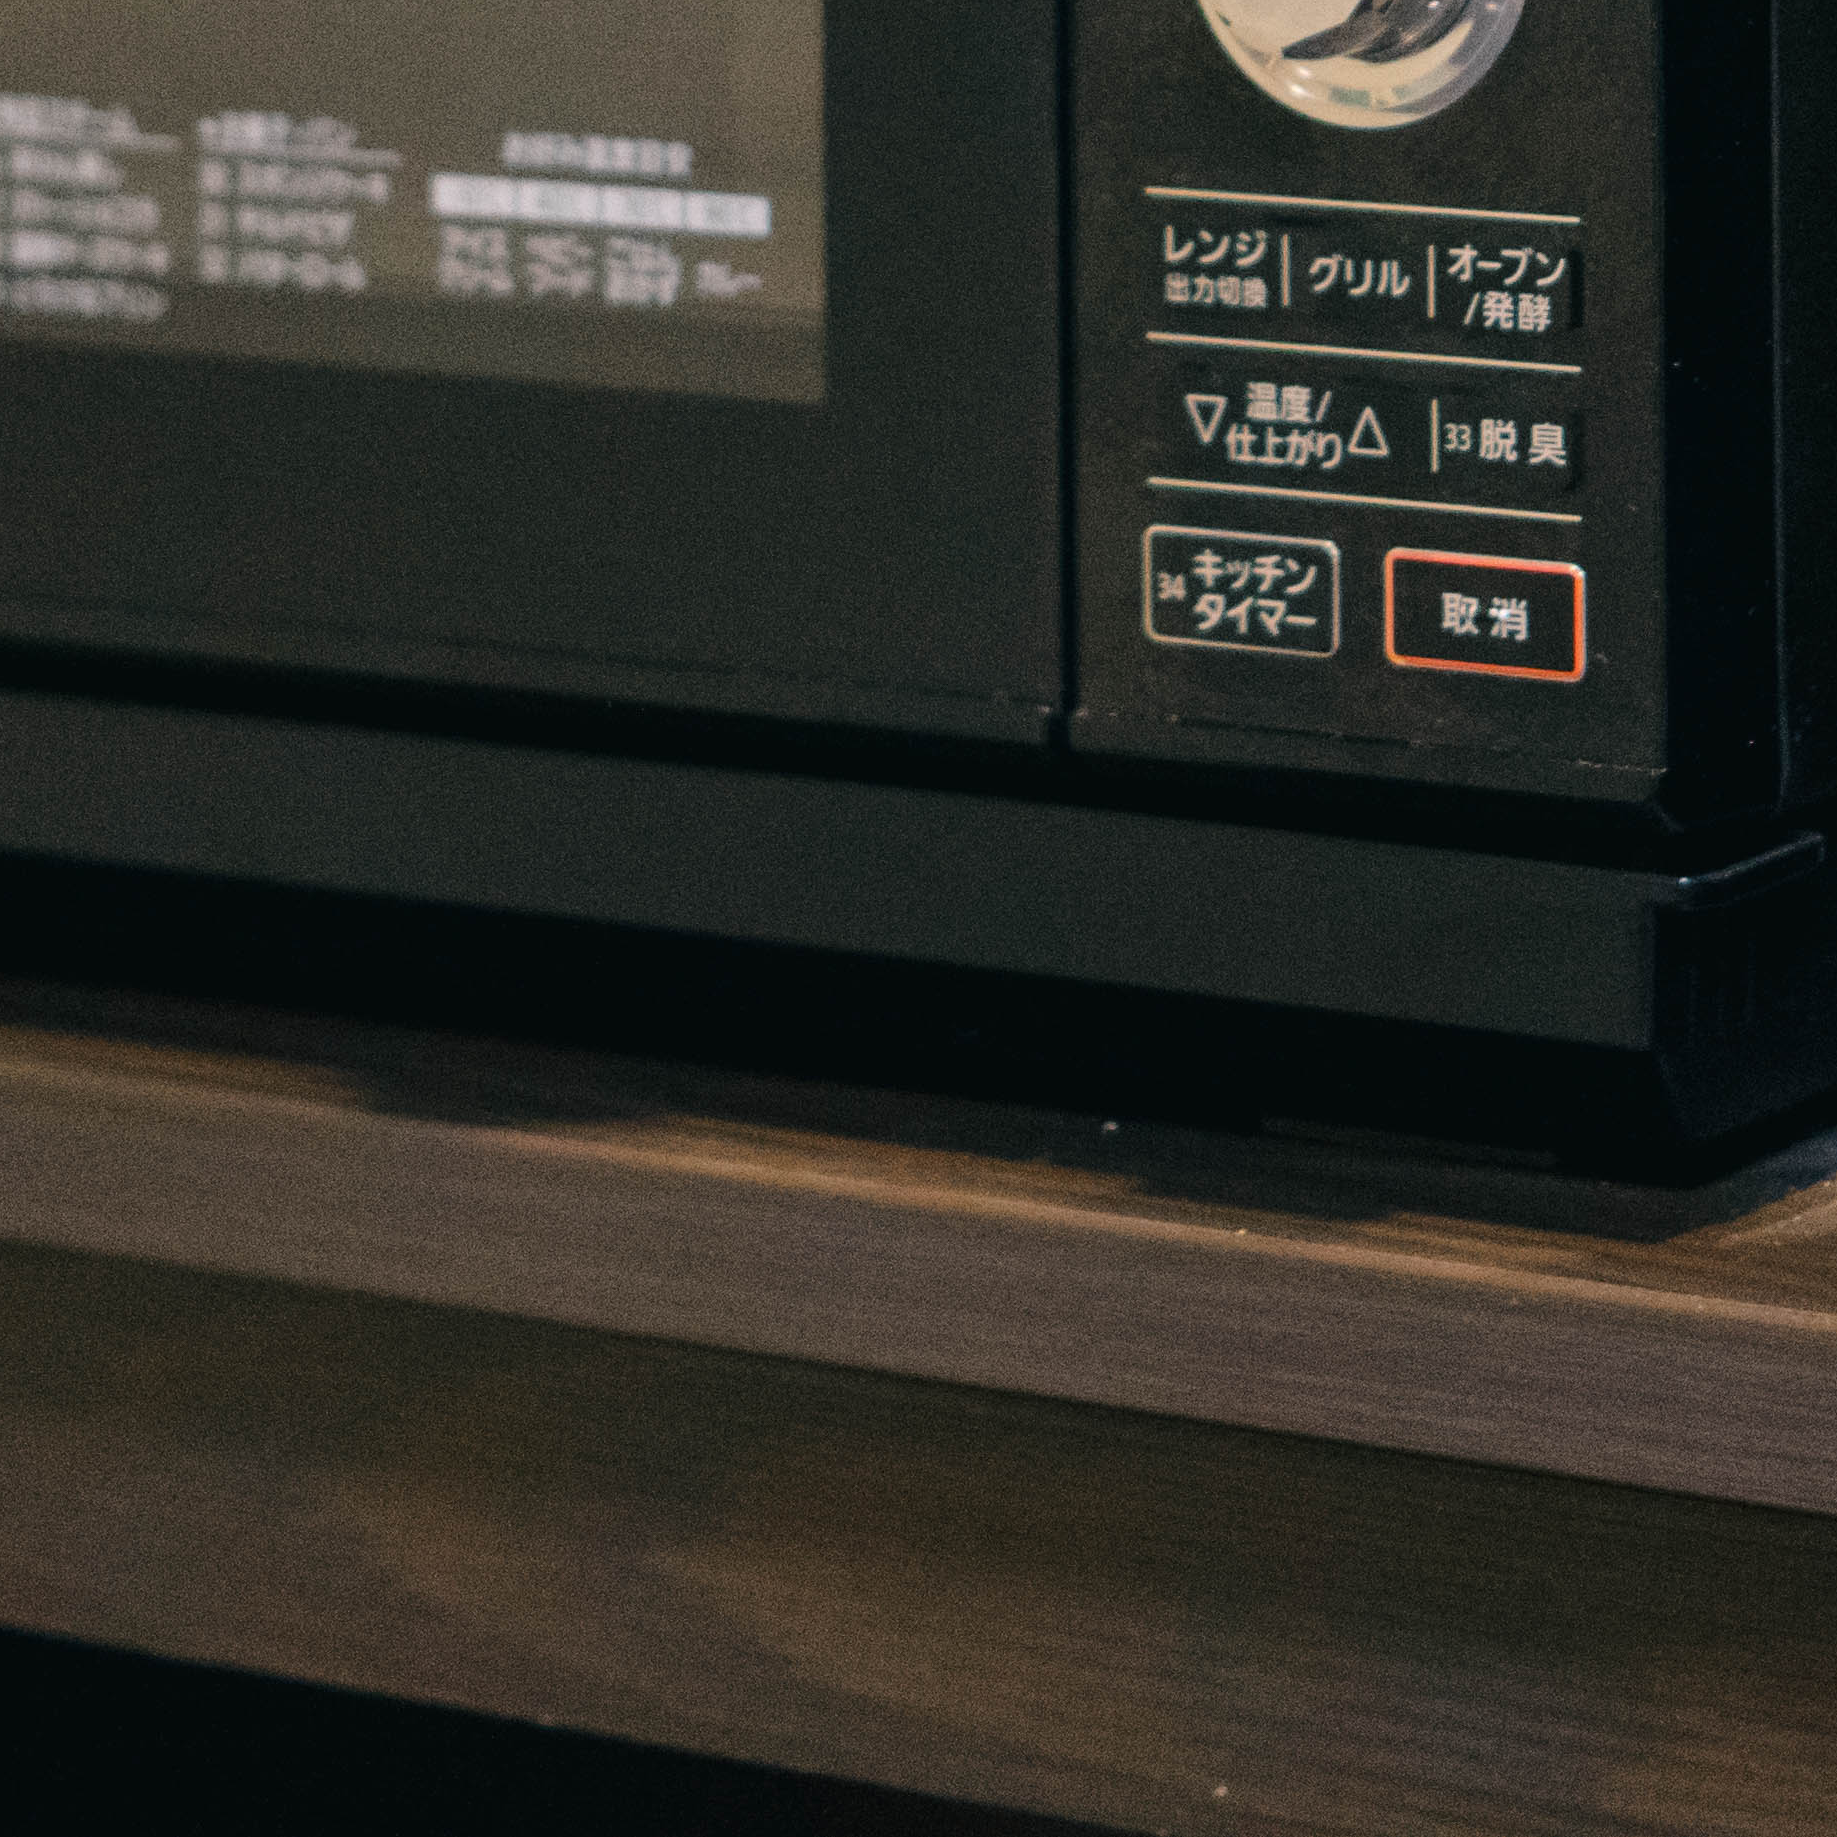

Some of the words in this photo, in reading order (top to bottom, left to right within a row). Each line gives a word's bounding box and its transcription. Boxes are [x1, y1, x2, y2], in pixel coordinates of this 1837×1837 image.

[1164, 225, 1268, 268] レンジ
[1447, 243, 1567, 288] オーブン
[1308, 253, 1412, 298] グリル
[1224, 422, 1344, 470] 仕上がり
[1444, 422, 1473, 453] 33
[1192, 547, 1319, 596] キッチン
[1193, 593, 1318, 636] タイマー
[1441, 591, 1529, 642] 取消
